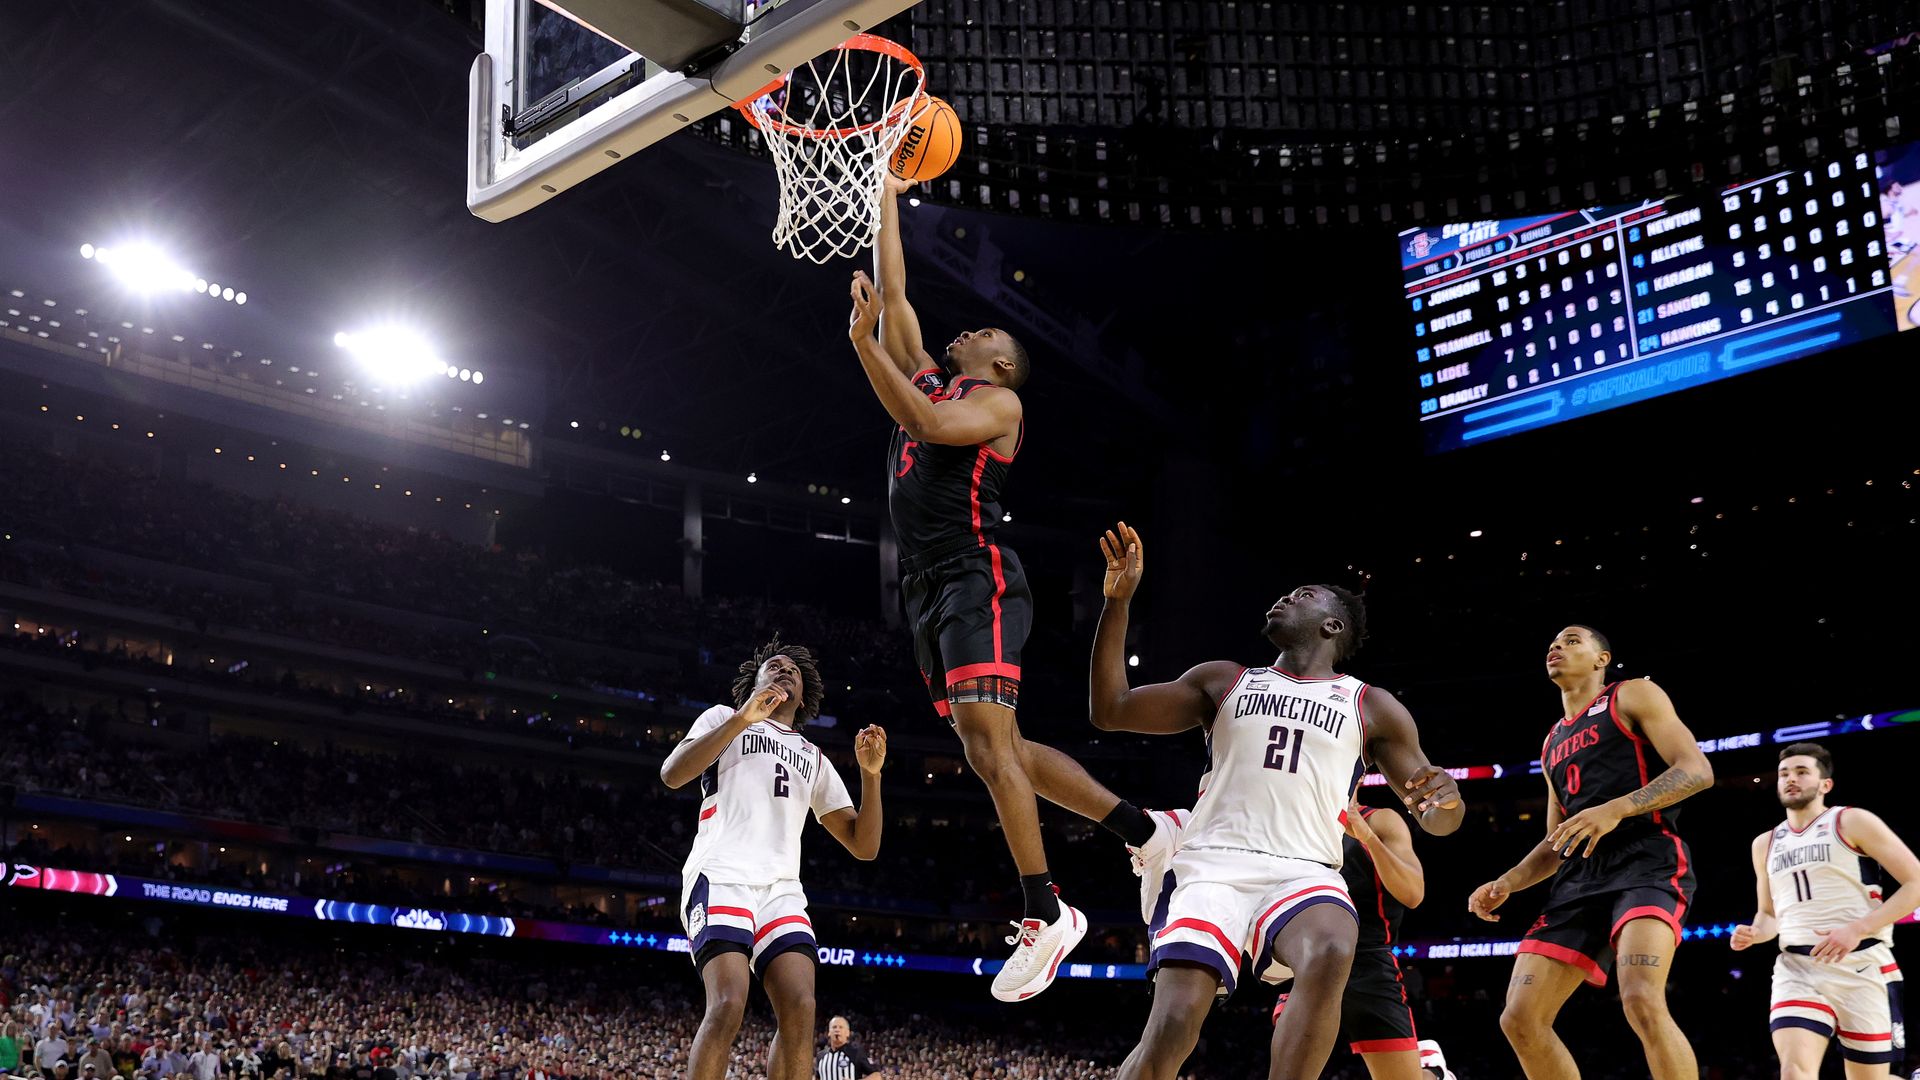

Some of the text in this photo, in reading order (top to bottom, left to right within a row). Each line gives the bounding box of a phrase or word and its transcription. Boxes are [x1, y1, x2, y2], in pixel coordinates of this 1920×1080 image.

[896, 125, 926, 174] Wilson
[1629, 227, 1640, 243] 2
[1646, 207, 1701, 237] NEWTON
[1751, 187, 1762, 203] 7
[1776, 179, 1789, 195] 3
[1804, 170, 1813, 186] 1
[1828, 162, 1840, 178] 0
[1855, 153, 1868, 170] 2
[1459, 220, 1500, 247] STATE
[1521, 224, 1552, 243] BONUS
[1633, 254, 1645, 268] 4
[1651, 235, 1704, 264] ALLEYNE
[1754, 215, 1767, 232] 2
[1779, 207, 1792, 223] 0
[1805, 199, 1818, 215] 0
[1832, 190, 1845, 207] 0
[1861, 182, 1870, 198] 1
[1413, 298, 1422, 311] 0
[1428, 279, 1480, 306] JOHNSON
[1516, 264, 1526, 279] 3
[1538, 258, 1546, 272] 1
[1558, 250, 1570, 266] 0
[1580, 243, 1592, 258] 0
[1603, 235, 1614, 251] 0
[1465, 244, 1492, 262] FOULS
[1636, 211, 1876, 296] 11 KARABAN 5 3 0 0 2 0
[1416, 262, 1618, 336] 5 BUTLER 11 3 2 0 1 0
[1637, 307, 1654, 324] 21
[1657, 291, 1710, 319] SANOGO
[1789, 264, 1799, 280] 1
[1813, 256, 1826, 273] 0
[1840, 248, 1853, 265] 2
[1868, 240, 1880, 257] 2
[1417, 289, 1622, 362] 12 TRAMMELL 11 3 1 2 0 3
[1639, 334, 1660, 352] 24
[1661, 317, 1721, 346] HAWKINS
[1766, 300, 1779, 315] 4
[1791, 292, 1804, 309] 0
[1820, 285, 1829, 301] 1
[1846, 277, 1856, 293] 1
[1872, 269, 1885, 286] 2
[1437, 362, 1470, 384] LEDEE
[1504, 348, 1514, 363] 7
[1525, 342, 1536, 357] 3
[1548, 336, 1557, 350] 1
[1590, 322, 1602, 338] 0
[1613, 316, 1625, 332] 2
[1421, 398, 1438, 414] 20
[1439, 383, 1488, 409] BRADLEY
[1552, 362, 1560, 377] 1
[1574, 356, 1582, 371] 1
[1594, 350, 1606, 365] 0
[1618, 343, 1627, 358] 1
[896, 441, 918, 478] 5
[1235, 693, 1347, 739] CONNECTICUT
[742, 734, 813, 784] CONNECTICUT
[1263, 725, 1304, 774] 21
[1550, 724, 1600, 770] AZTECS
[1718, 732, 1761, 751] HERE
[774, 762, 789, 798] 2
[1566, 763, 1581, 795] 0
[1772, 843, 1831, 874] CONNECTICUT
[143, 883, 288, 911] THE ROAD ENDS HERE
[1792, 869, 1812, 902] 11
[817, 947, 855, 966] OUR
[1428, 944, 1460, 958] 2023
[1460, 943, 1492, 957] NCAA
